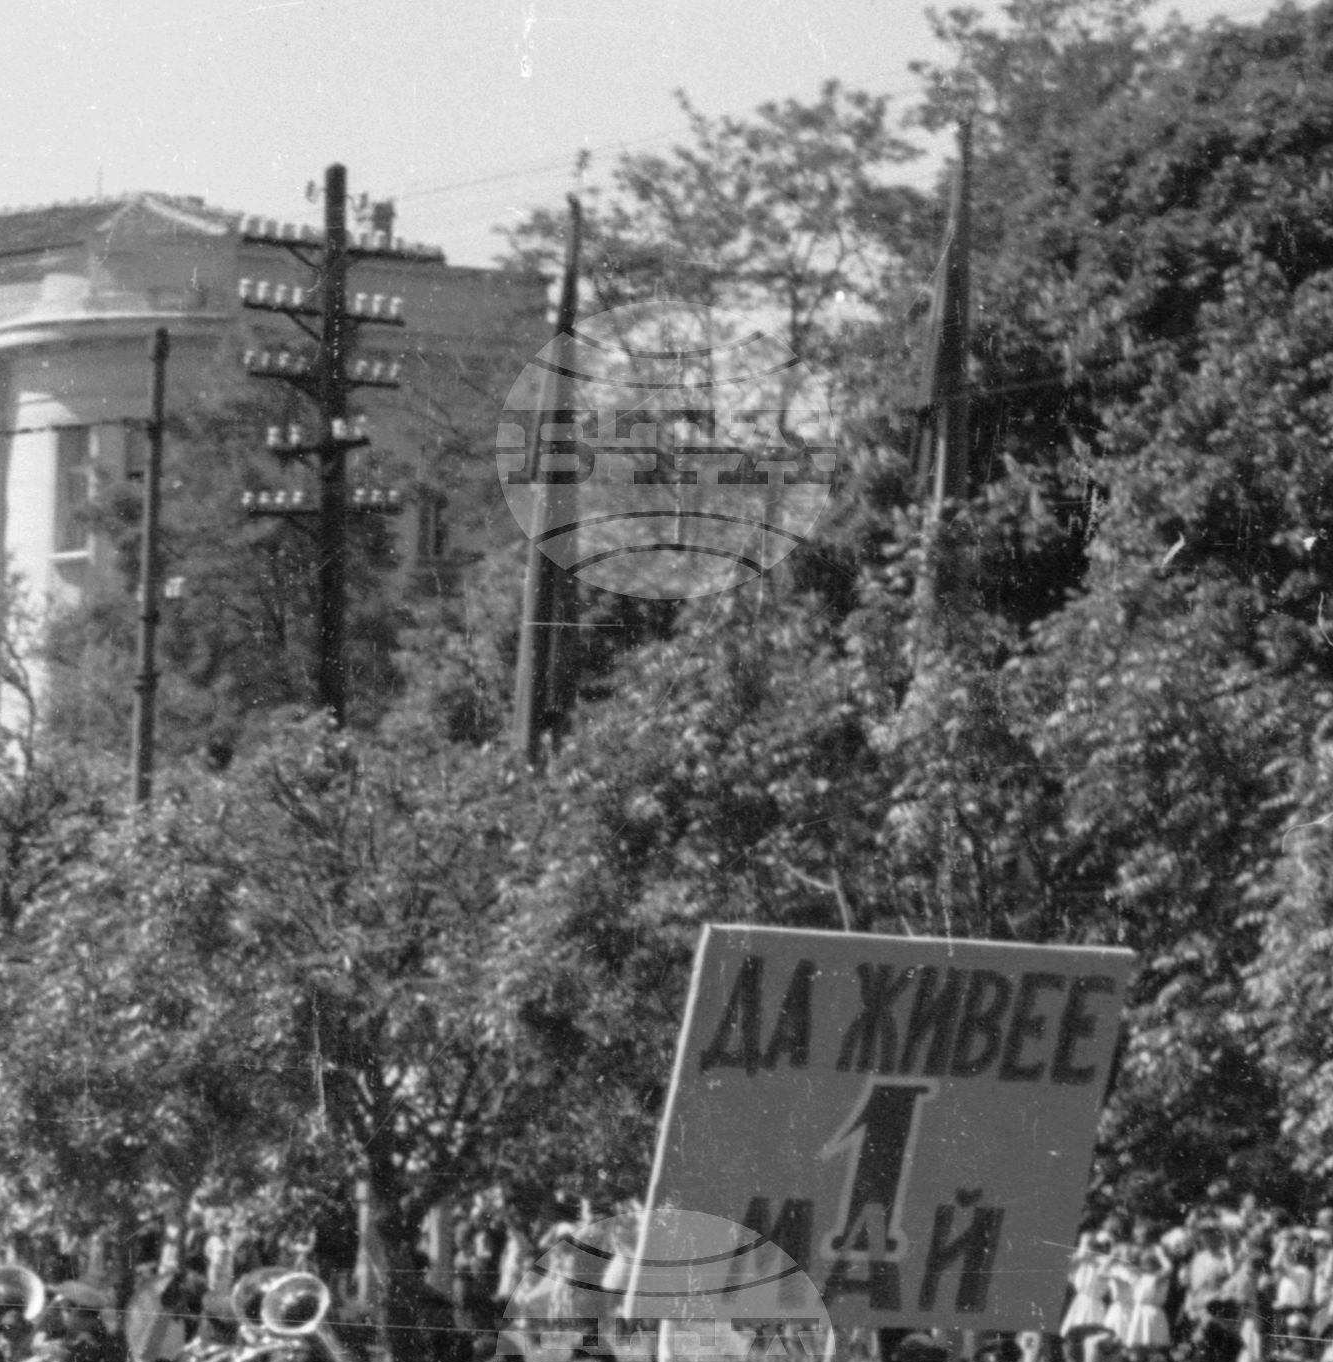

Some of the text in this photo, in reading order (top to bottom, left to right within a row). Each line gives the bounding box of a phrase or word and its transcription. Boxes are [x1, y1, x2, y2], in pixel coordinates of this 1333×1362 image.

[698, 955, 1116, 1086] ДА ЖИВЕЕ
[821, 1075, 938, 1262] 1
[724, 1186, 1006, 1314] МАЙ
